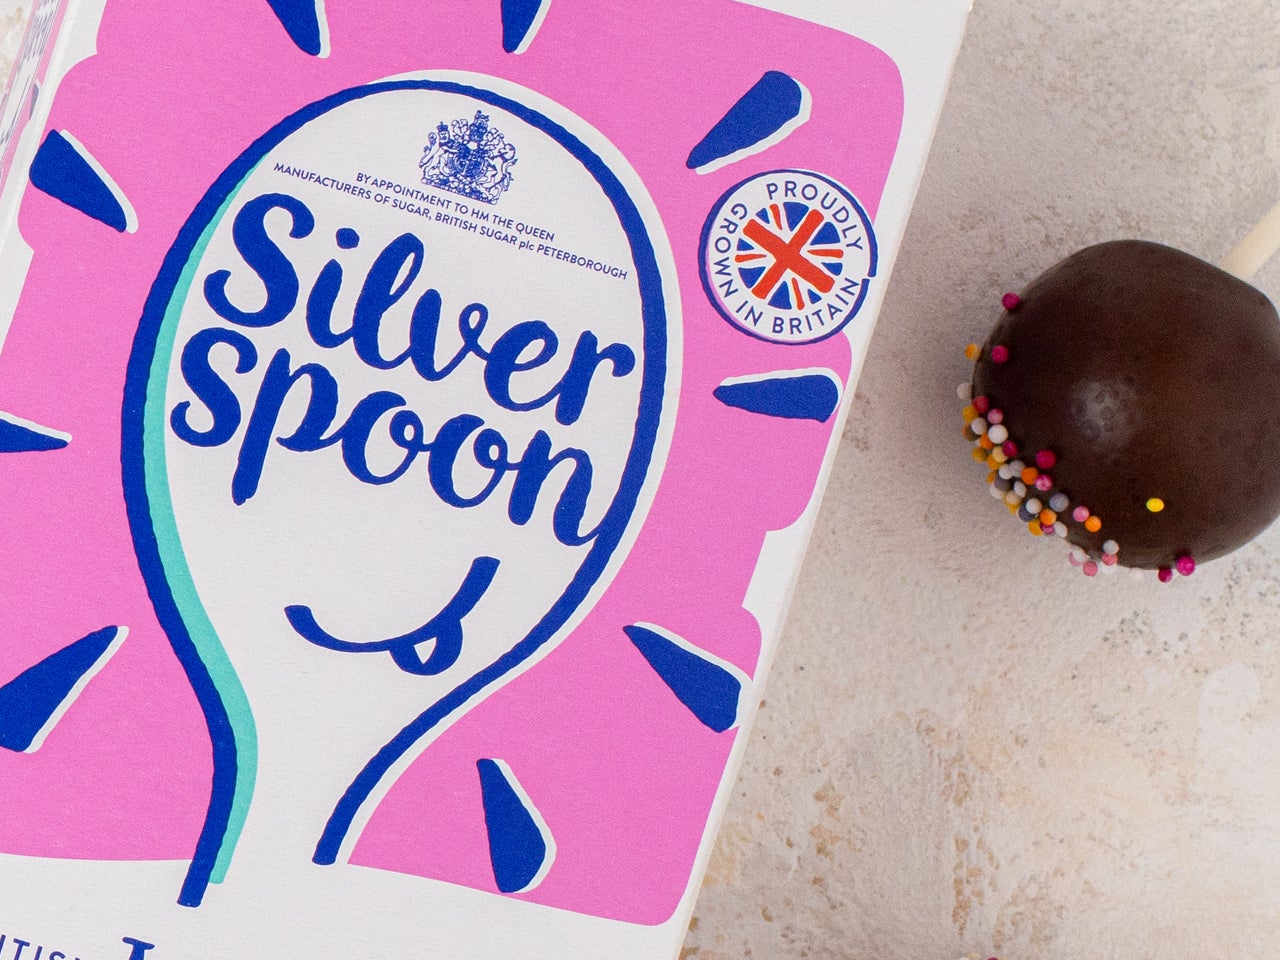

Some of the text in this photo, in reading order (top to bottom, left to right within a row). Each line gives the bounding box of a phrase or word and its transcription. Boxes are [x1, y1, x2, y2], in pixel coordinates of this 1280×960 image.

[273, 162, 629, 280] MANUFACTURERS OF SUGAR, BRITISH SUGAR plc PETERBOROUGH
[356, 172, 555, 242] BY APPOINTMENT TO HM THE QUEEN
[765, 180, 864, 251] PROUDLY
[203, 192, 636, 426] Silver
[713, 202, 861, 335] GROWN IN BRITAIN
